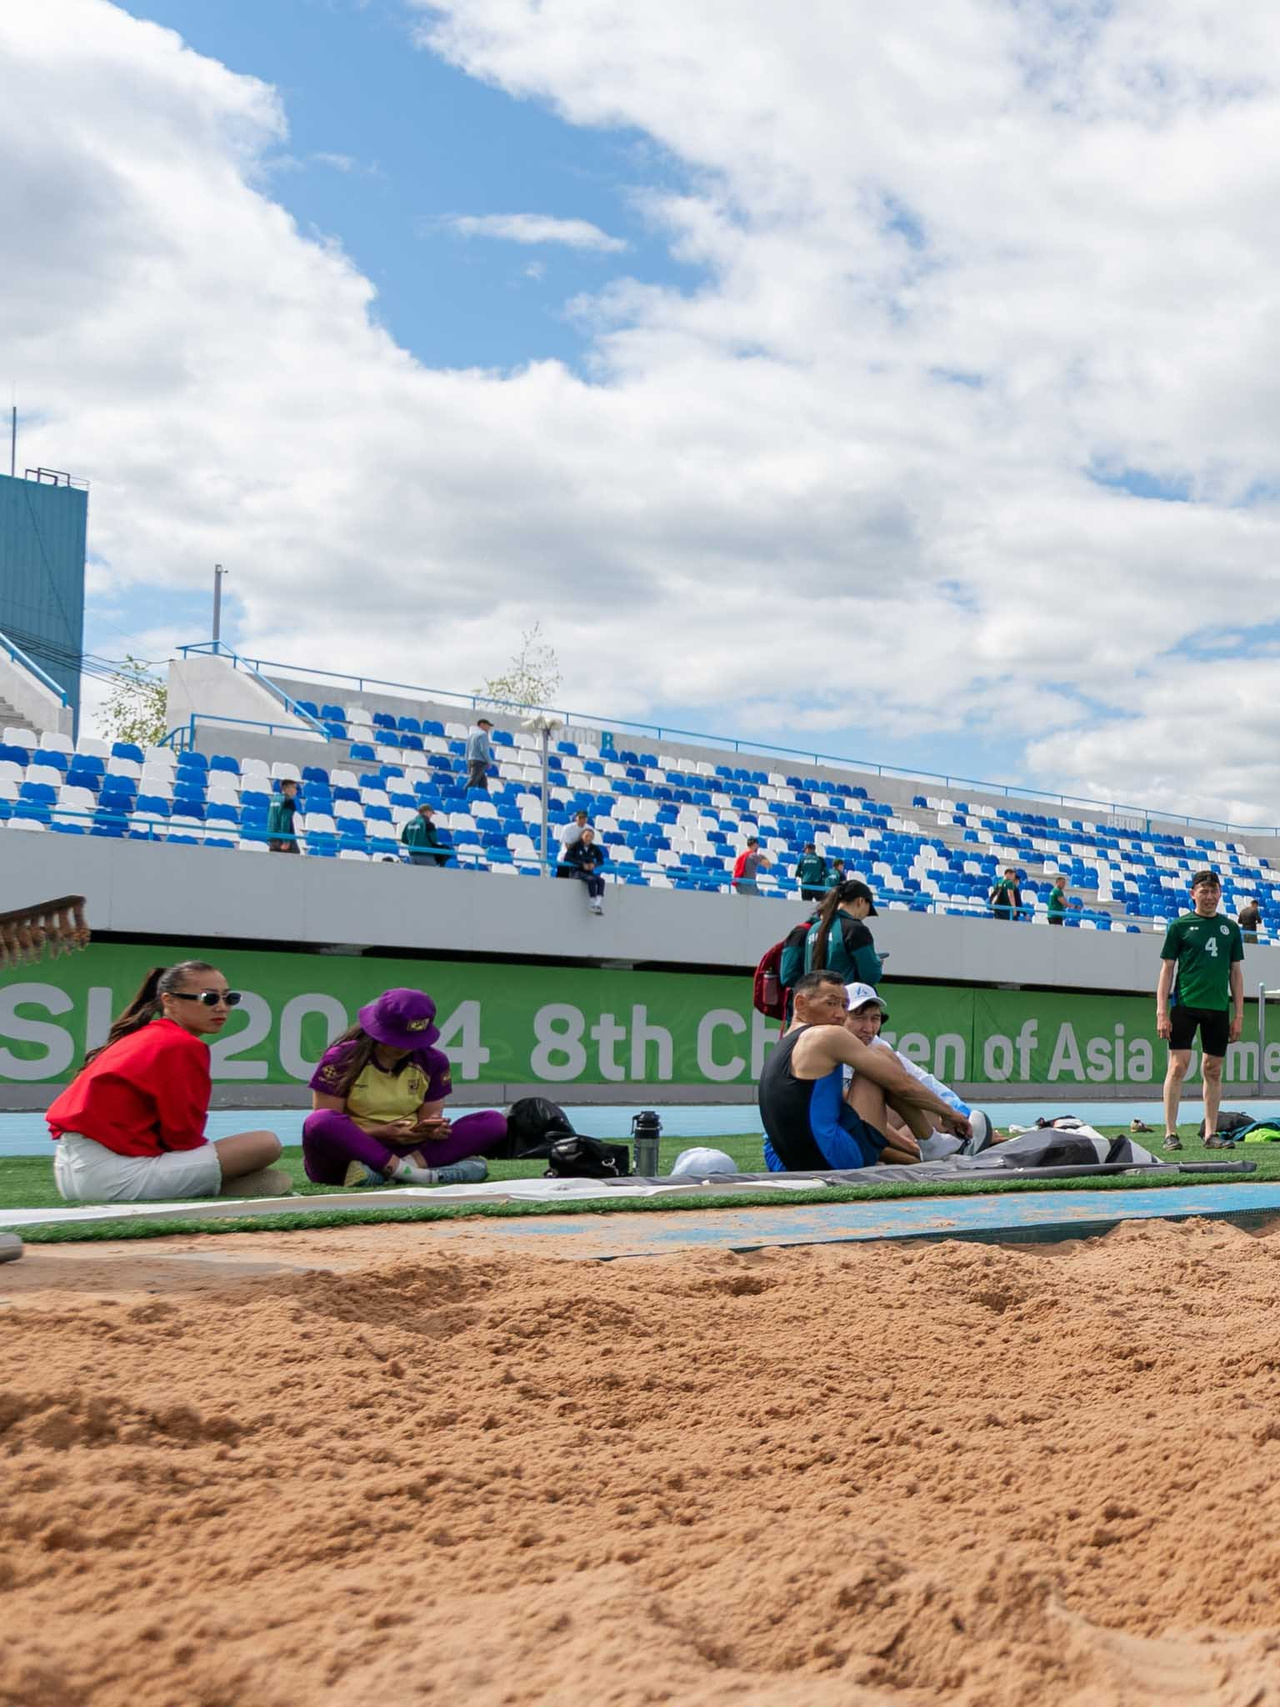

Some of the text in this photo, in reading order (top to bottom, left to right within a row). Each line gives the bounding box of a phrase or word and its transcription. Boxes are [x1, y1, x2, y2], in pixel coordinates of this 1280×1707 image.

[1205, 937, 1218, 957] 4
[205, 986, 490, 1081] 204
[530, 1003, 673, 1081] 8th
[697, 1007, 965, 1082] Chen
[983, 1019, 1038, 1082] of
[1048, 1022, 1153, 1082] Asia
